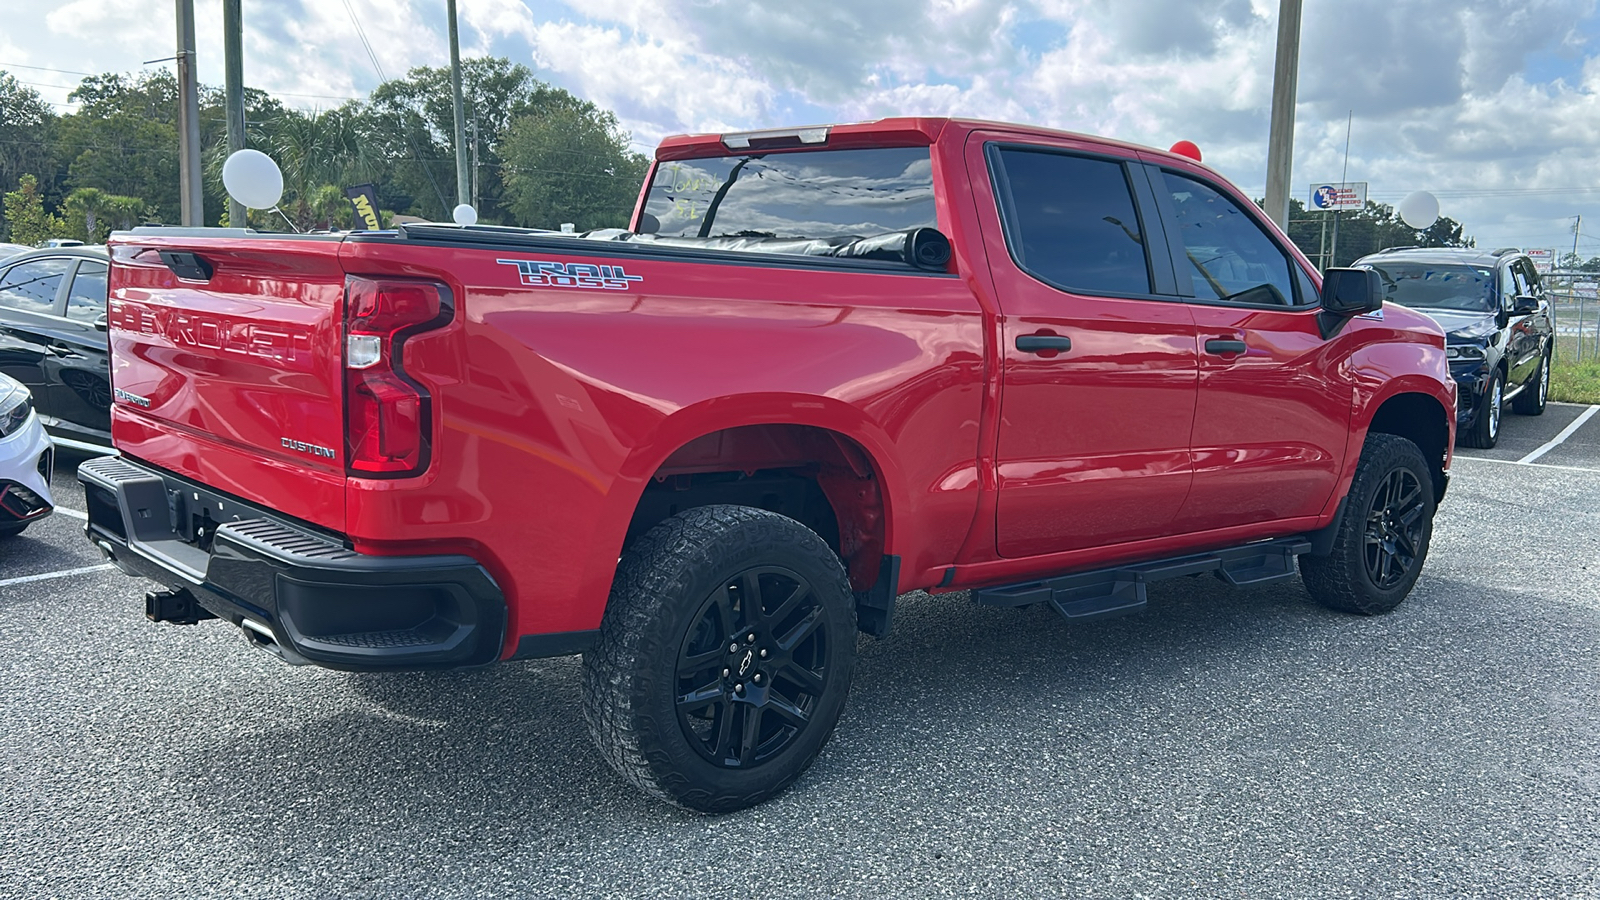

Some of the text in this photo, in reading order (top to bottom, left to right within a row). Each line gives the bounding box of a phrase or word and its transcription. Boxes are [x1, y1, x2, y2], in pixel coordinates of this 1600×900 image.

[496, 259, 643, 281] TRAIL
[520, 273, 629, 290] BOSS
[281, 437, 335, 459] CUSTOM
